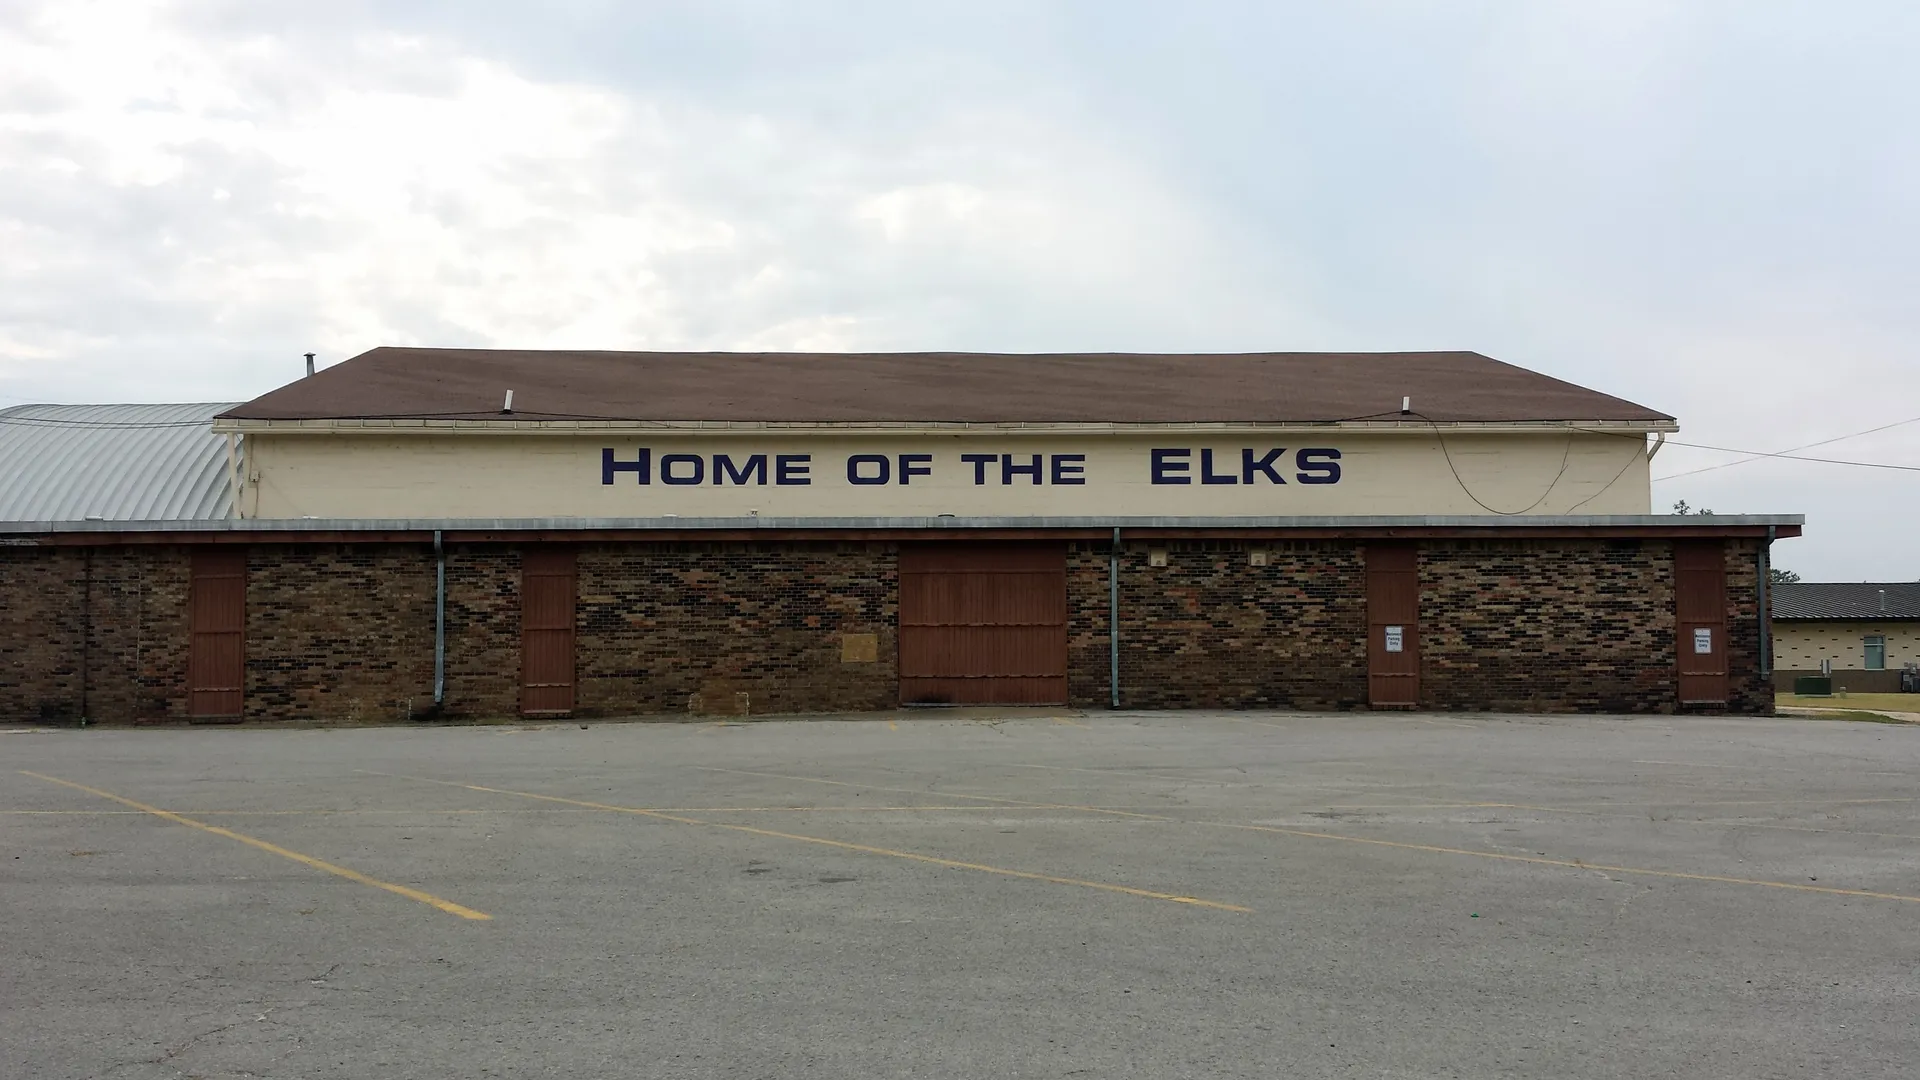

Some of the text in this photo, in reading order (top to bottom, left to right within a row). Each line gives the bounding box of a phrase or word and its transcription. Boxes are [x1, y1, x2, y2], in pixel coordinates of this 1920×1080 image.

[601, 448, 1342, 486] HOME OF THE ELKS
